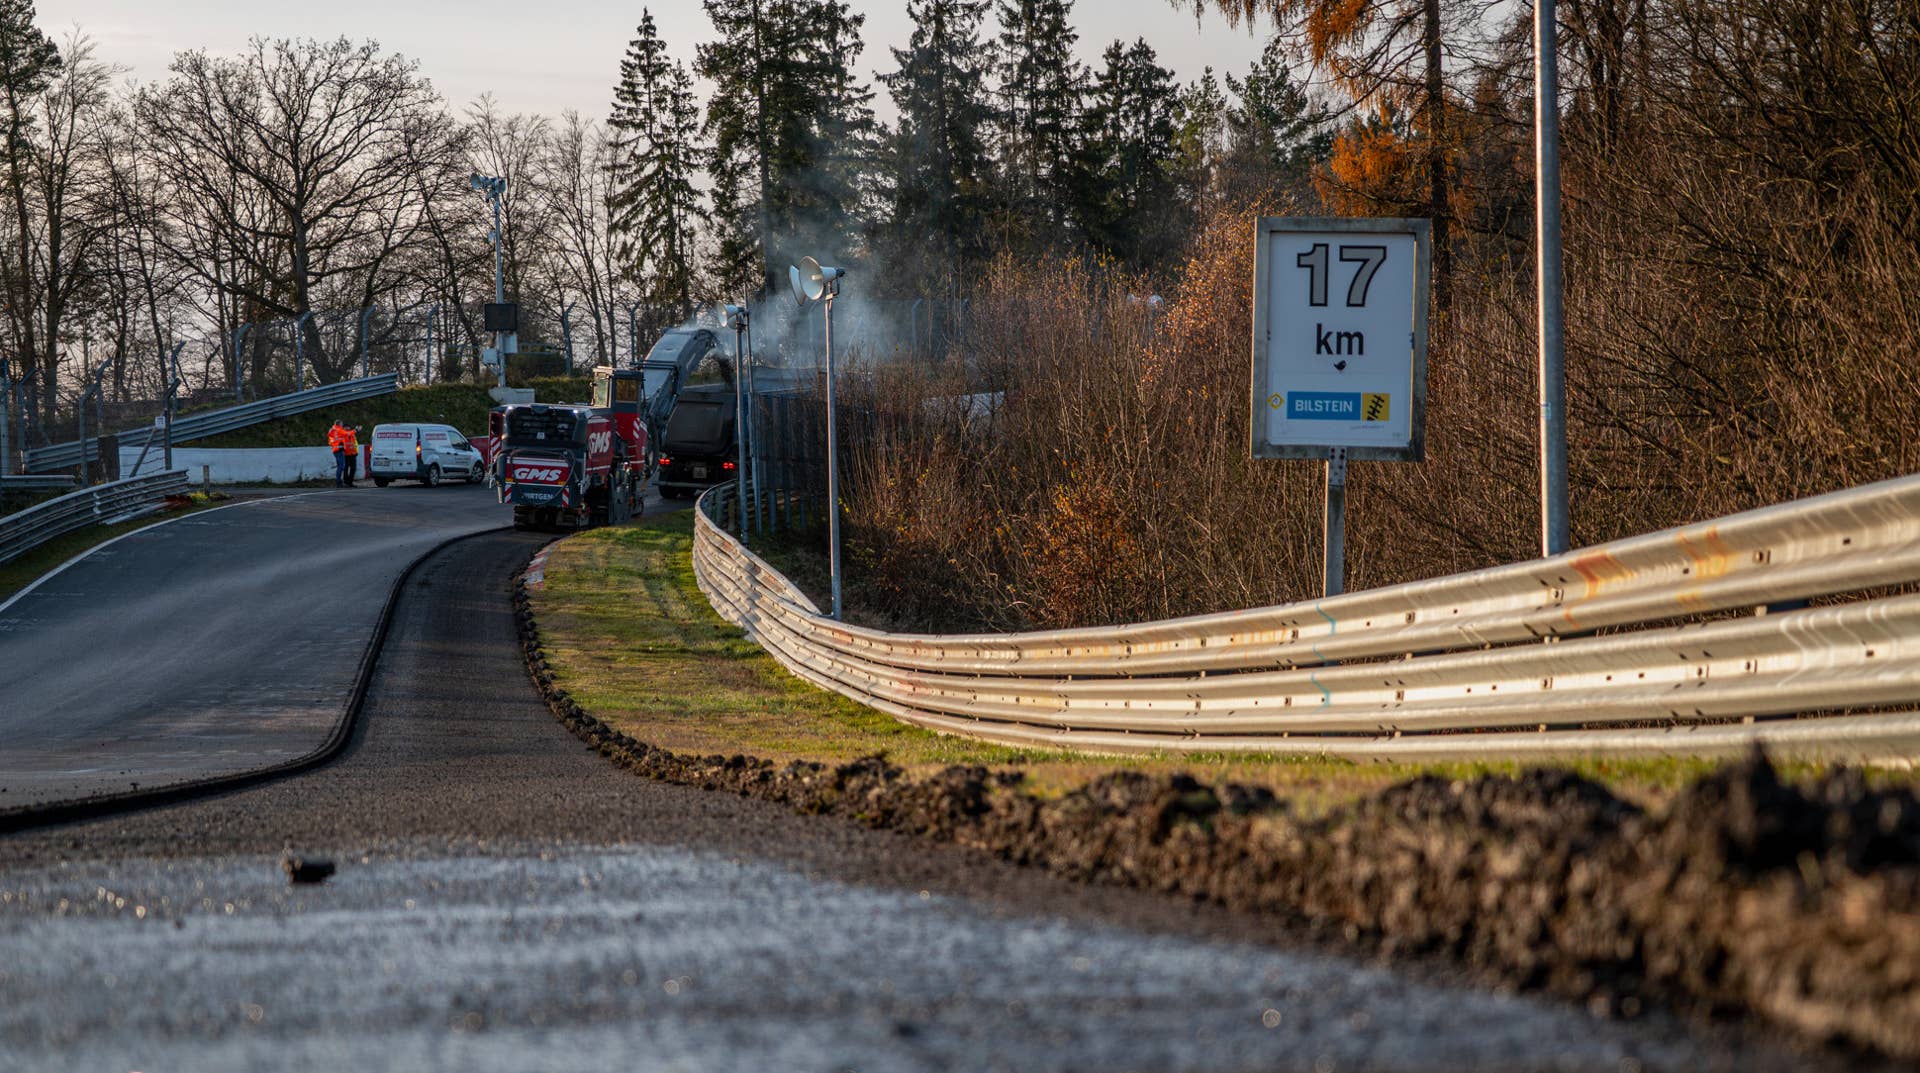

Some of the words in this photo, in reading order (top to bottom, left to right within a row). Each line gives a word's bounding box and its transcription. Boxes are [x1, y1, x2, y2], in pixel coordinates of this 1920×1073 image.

[1297, 243, 1387, 307] 17
[1316, 323, 1364, 355] km
[1295, 400, 1353, 412] BILSTEIN
[589, 431, 611, 455] GMS
[514, 468, 562, 481] GMS
